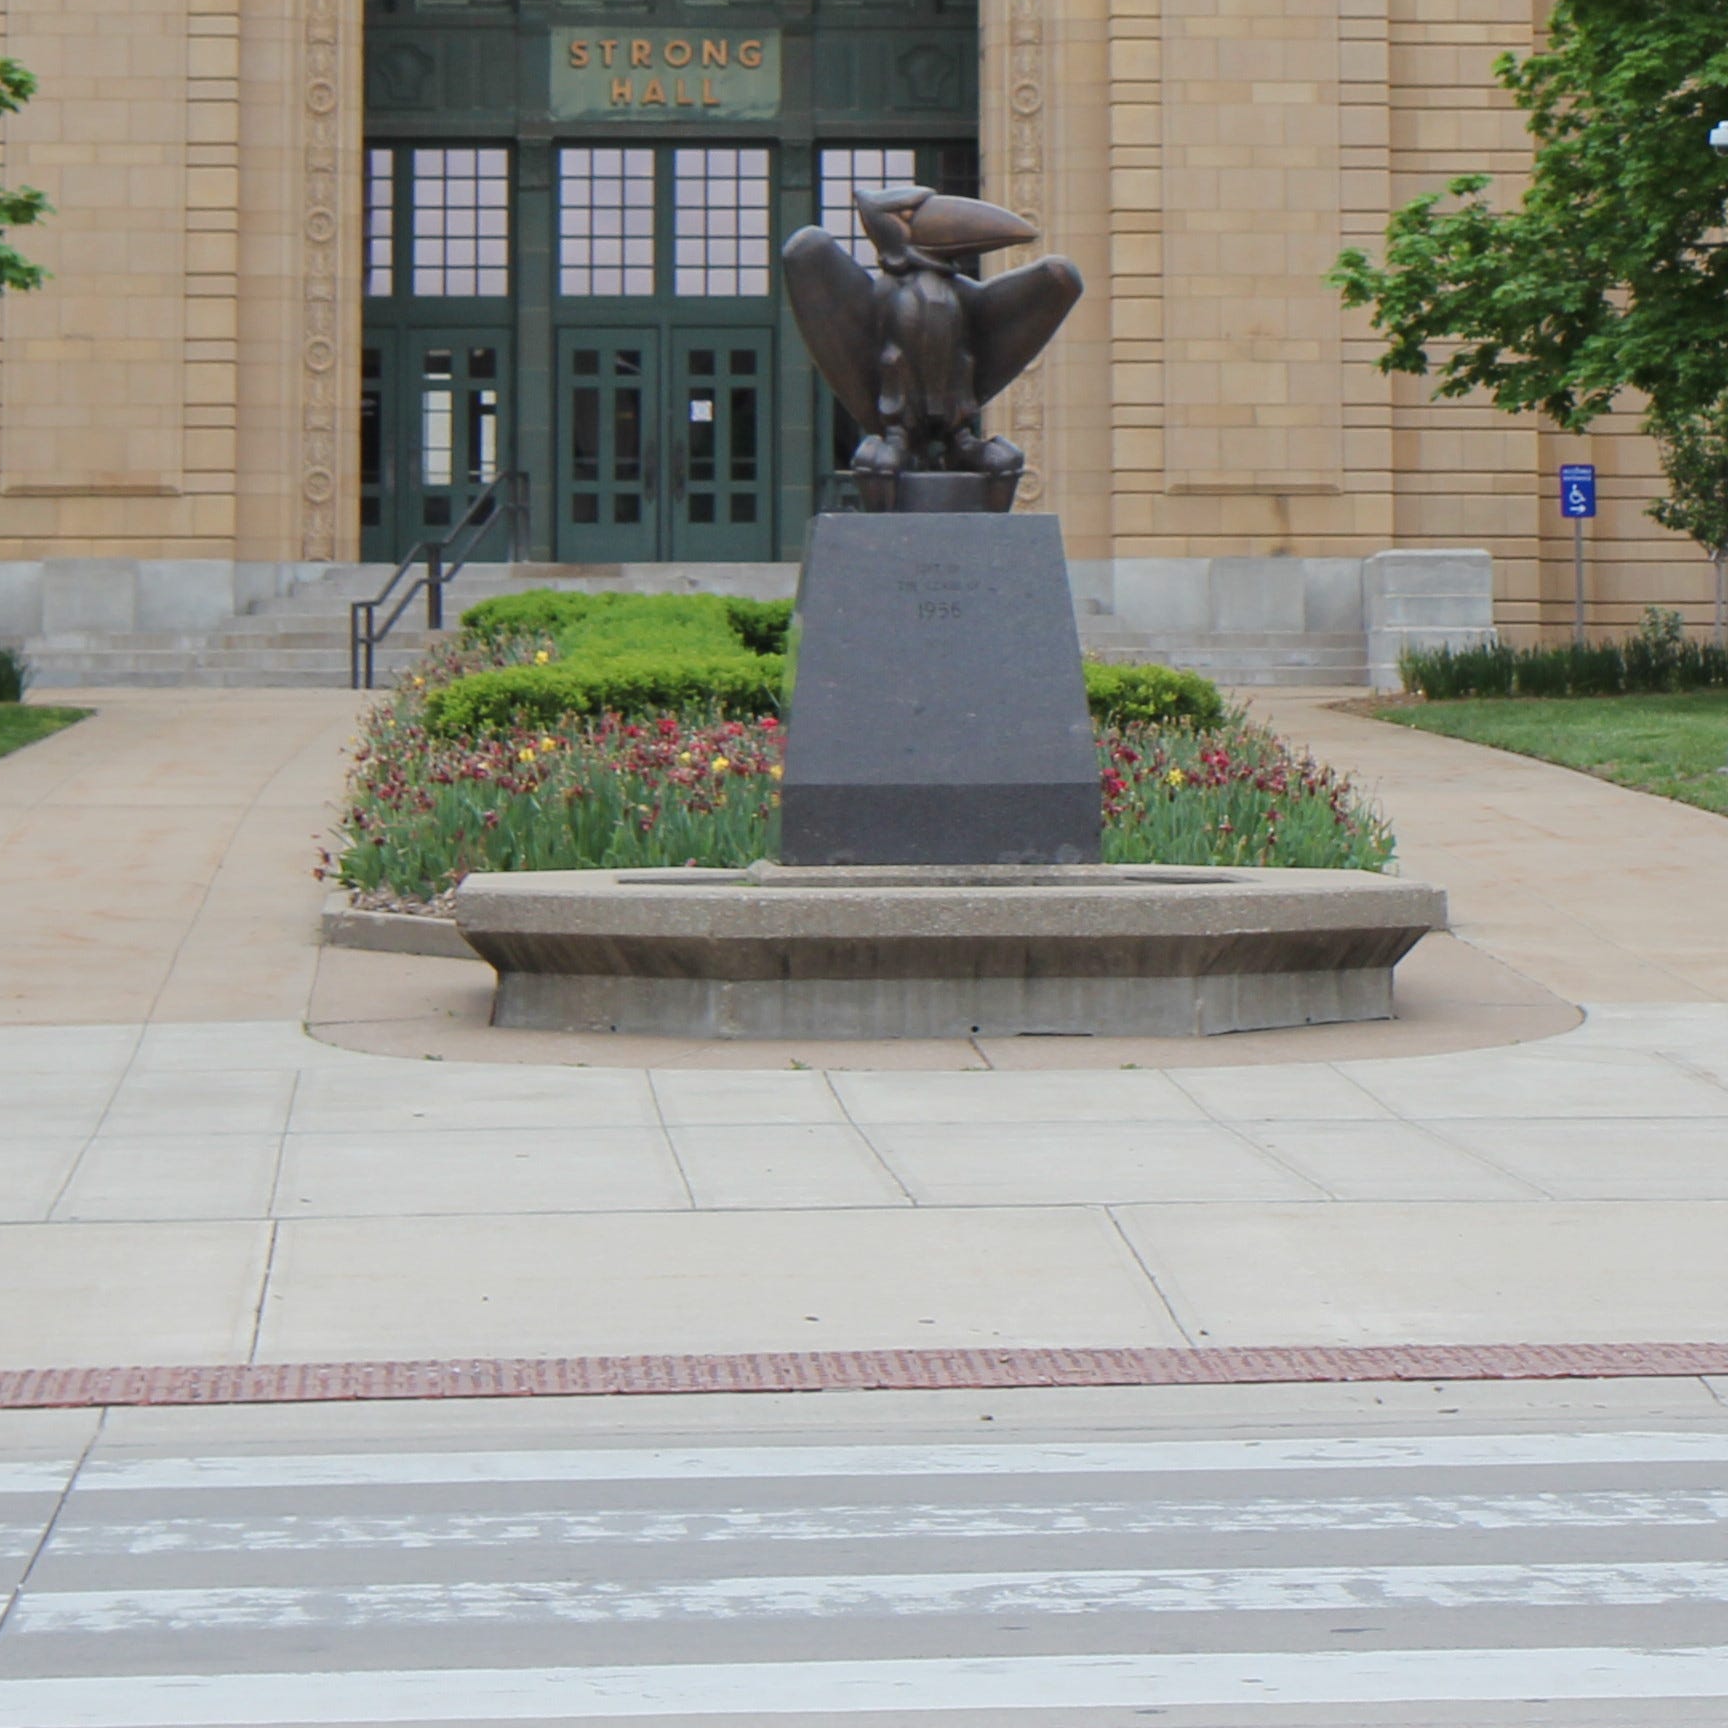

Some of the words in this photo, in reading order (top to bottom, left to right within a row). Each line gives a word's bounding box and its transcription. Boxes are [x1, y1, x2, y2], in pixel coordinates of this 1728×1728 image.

[570, 38, 763, 68] STRONG
[610, 78, 721, 106] HALL
[917, 600, 962, 620] 1956
